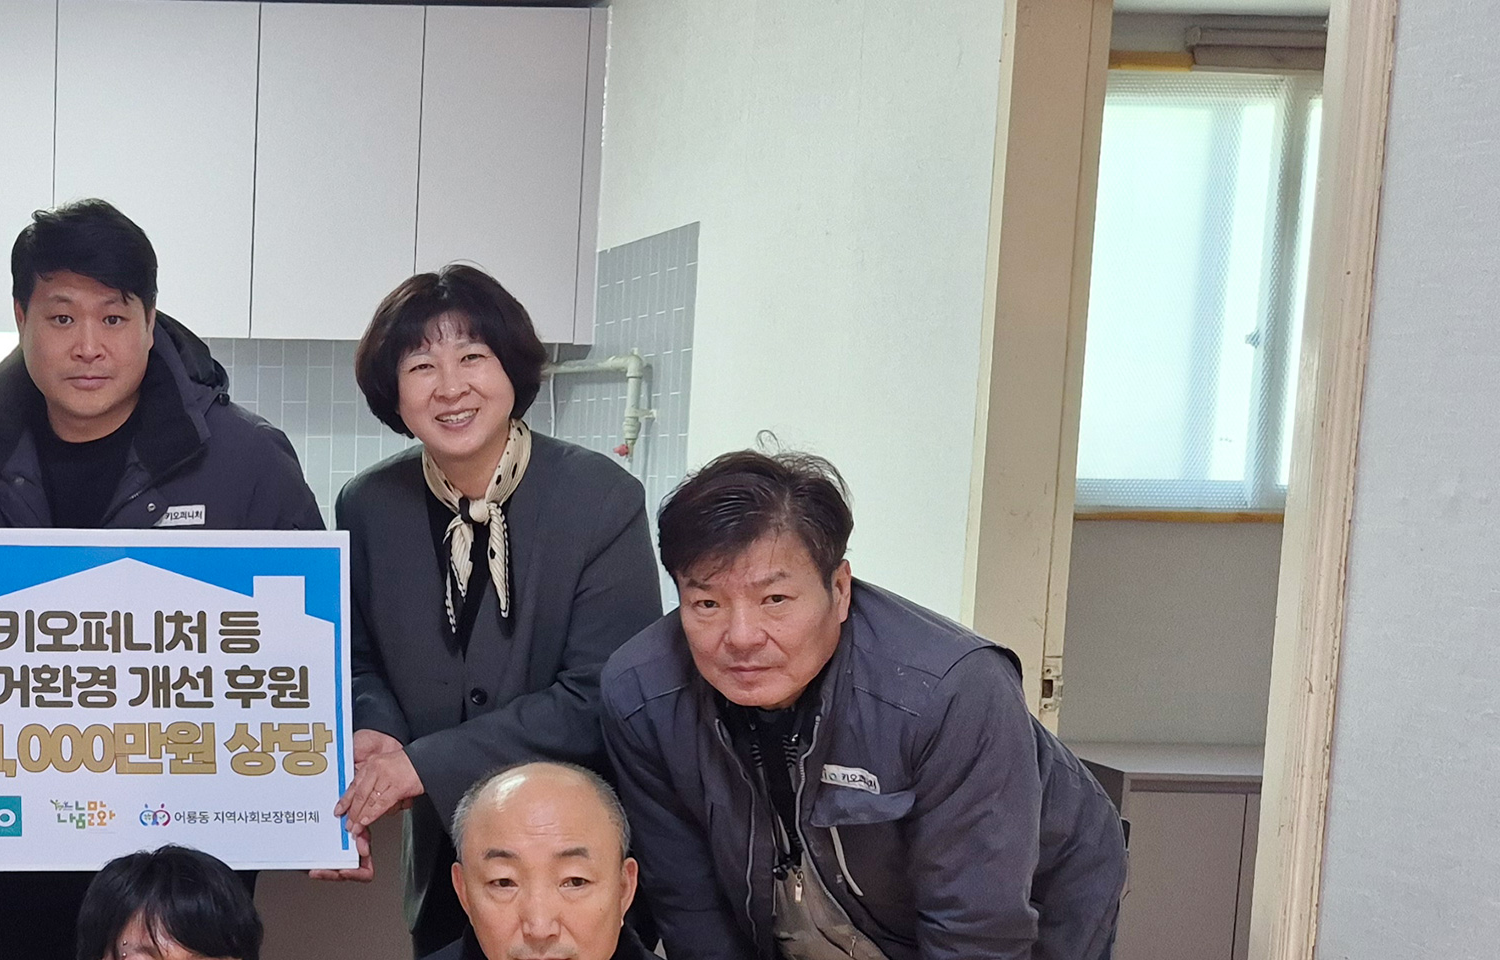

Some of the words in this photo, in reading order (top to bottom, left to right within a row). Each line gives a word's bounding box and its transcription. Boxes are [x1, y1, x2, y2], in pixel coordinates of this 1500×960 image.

[218, 611, 261, 653] 등
[128, 665, 214, 708] 개선
[224, 665, 310, 708] 후원
[223, 722, 333, 776] 상당
[174, 811, 210, 824] 어룡동
[213, 811, 320, 824] 지역사회보장협의체
